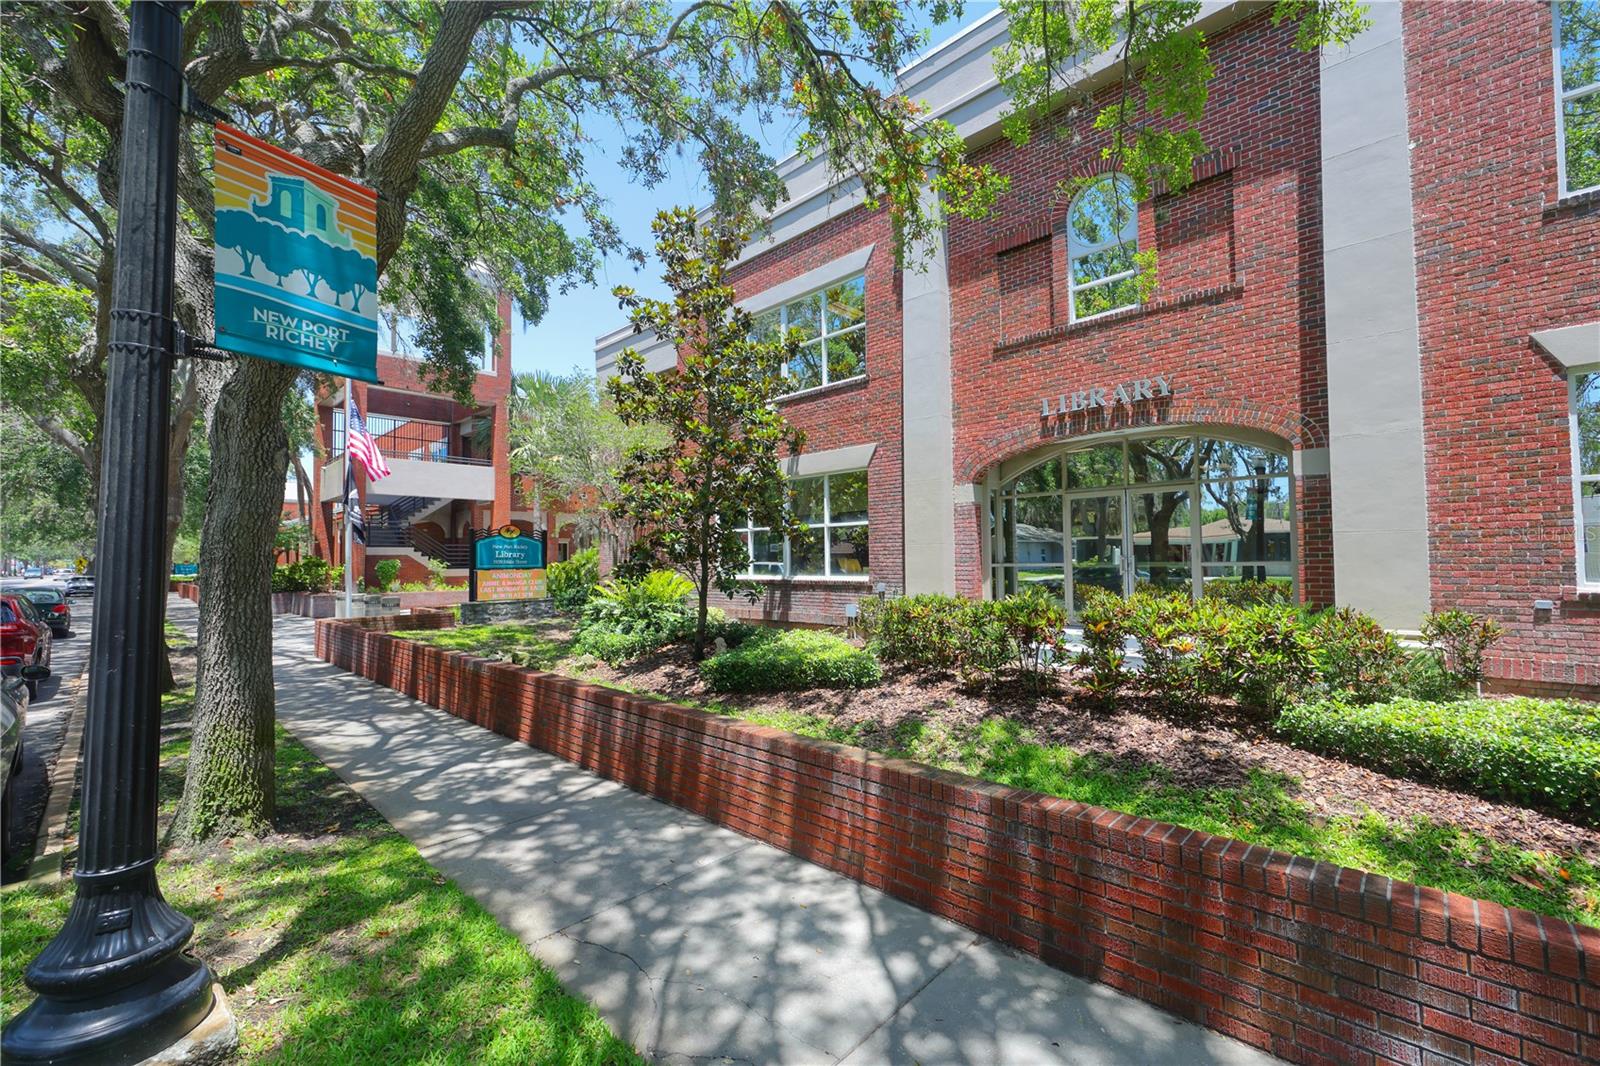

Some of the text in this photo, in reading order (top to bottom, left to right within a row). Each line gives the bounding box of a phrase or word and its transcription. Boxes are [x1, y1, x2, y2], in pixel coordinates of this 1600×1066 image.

[253, 306, 350, 341] NEW PORT
[266, 324, 338, 353] RICHEY
[1040, 374, 1173, 416] LIBRARY
[495, 550, 525, 559] Library
